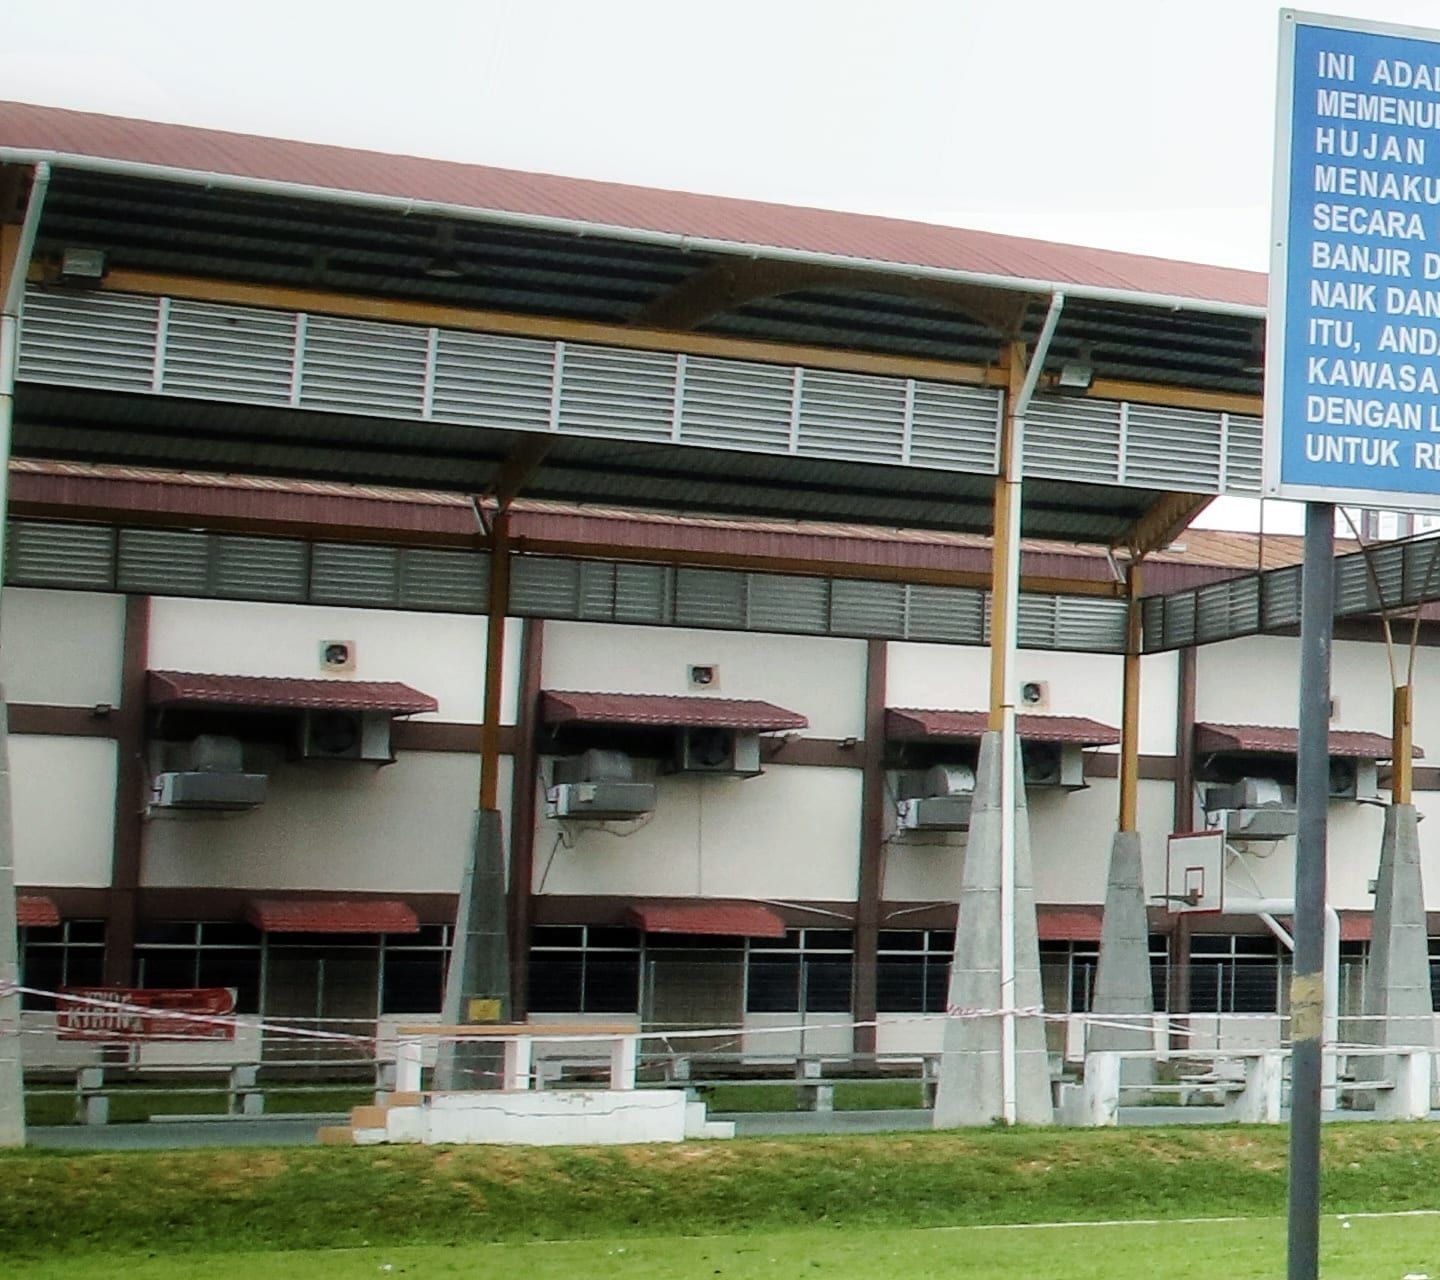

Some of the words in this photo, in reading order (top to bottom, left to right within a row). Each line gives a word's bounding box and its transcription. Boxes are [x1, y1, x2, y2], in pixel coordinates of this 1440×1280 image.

[1319, 51, 1354, 81] INI
[1316, 127, 1425, 165] HUJAN
[1313, 203, 1426, 241] SECARA
[1312, 241, 1411, 277] BANJIR
[1311, 279, 1376, 312] NAIK
[1309, 318, 1361, 353] ITU,
[1307, 395, 1422, 431] DENGAN
[1306, 433, 1399, 467] UNTUK
